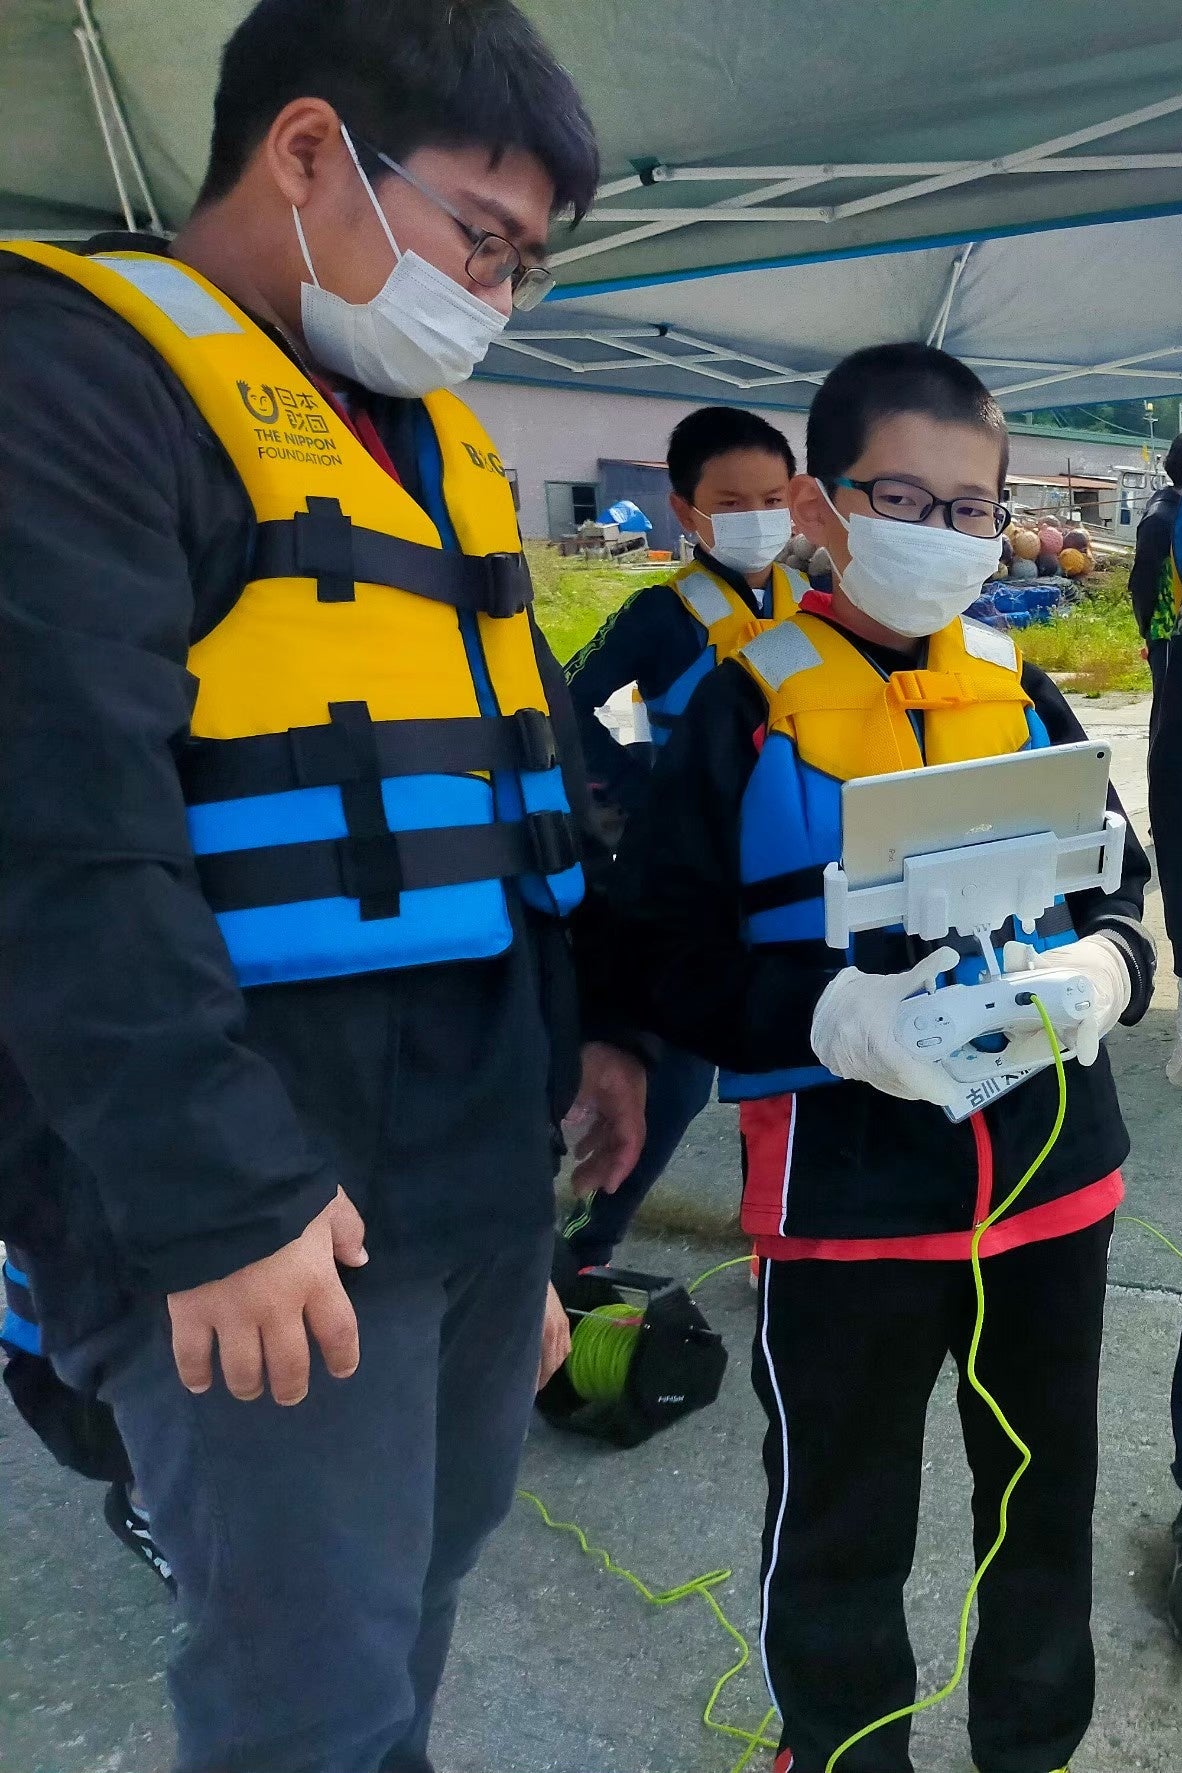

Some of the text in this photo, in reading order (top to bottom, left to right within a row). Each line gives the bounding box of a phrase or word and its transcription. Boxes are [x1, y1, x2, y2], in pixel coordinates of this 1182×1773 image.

[274, 386, 318, 410] 日本
[253, 428, 337, 451] THE NIPPON
[258, 446, 343, 467] FOUNDATION
